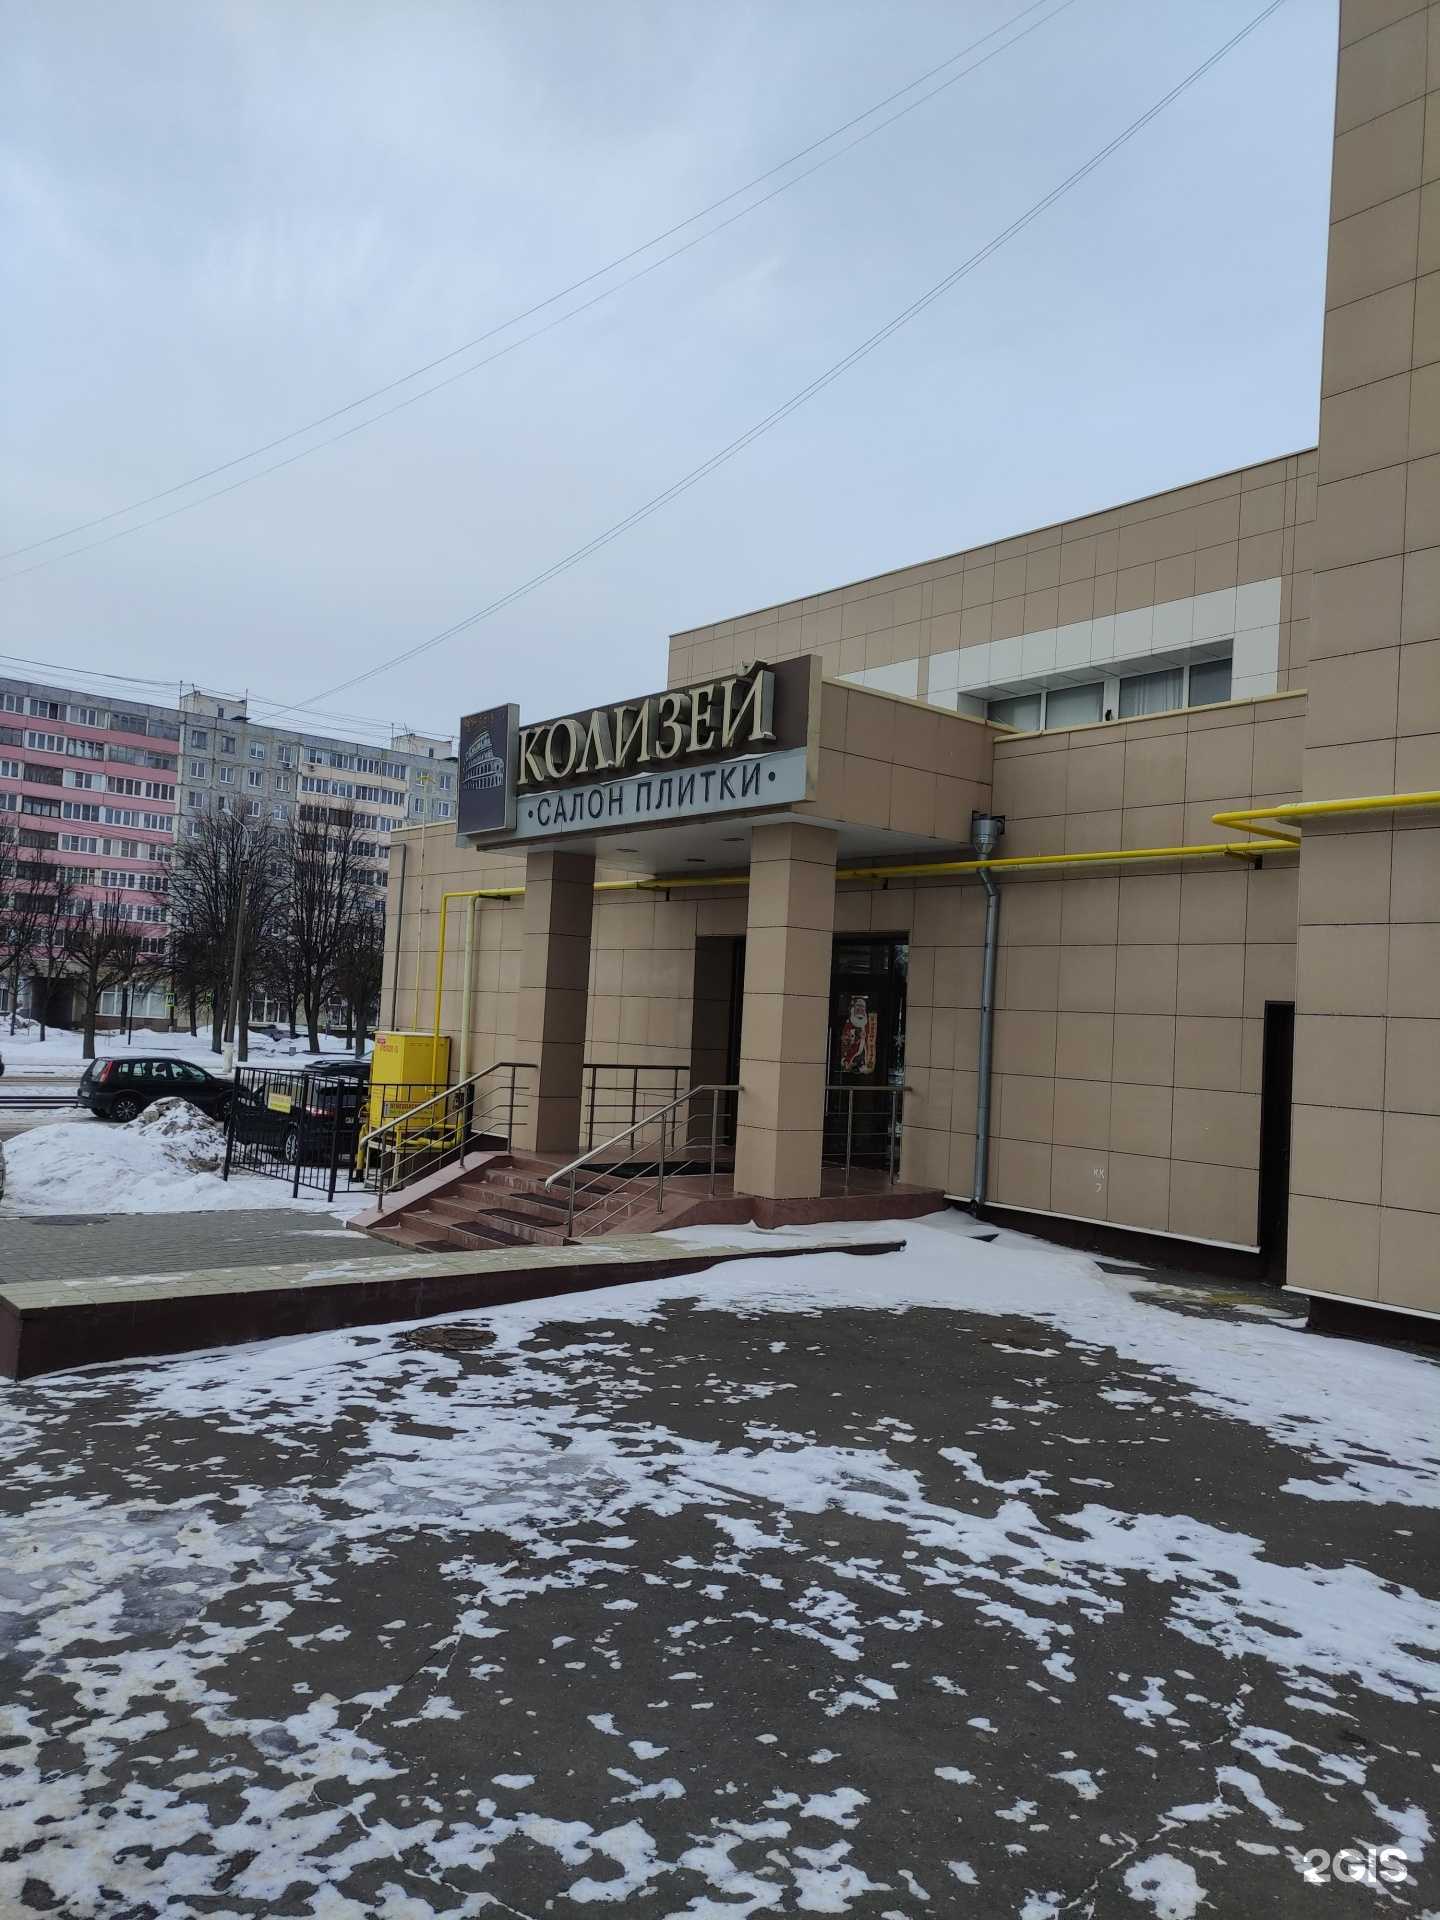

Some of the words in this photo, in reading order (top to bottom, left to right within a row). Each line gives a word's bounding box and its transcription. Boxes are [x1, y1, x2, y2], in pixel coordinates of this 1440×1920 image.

[519, 659, 776, 784] КОЛИЗЕЙ
[537, 787, 624, 826] САЛОН
[635, 763, 762, 812] ПЛИТКИ
